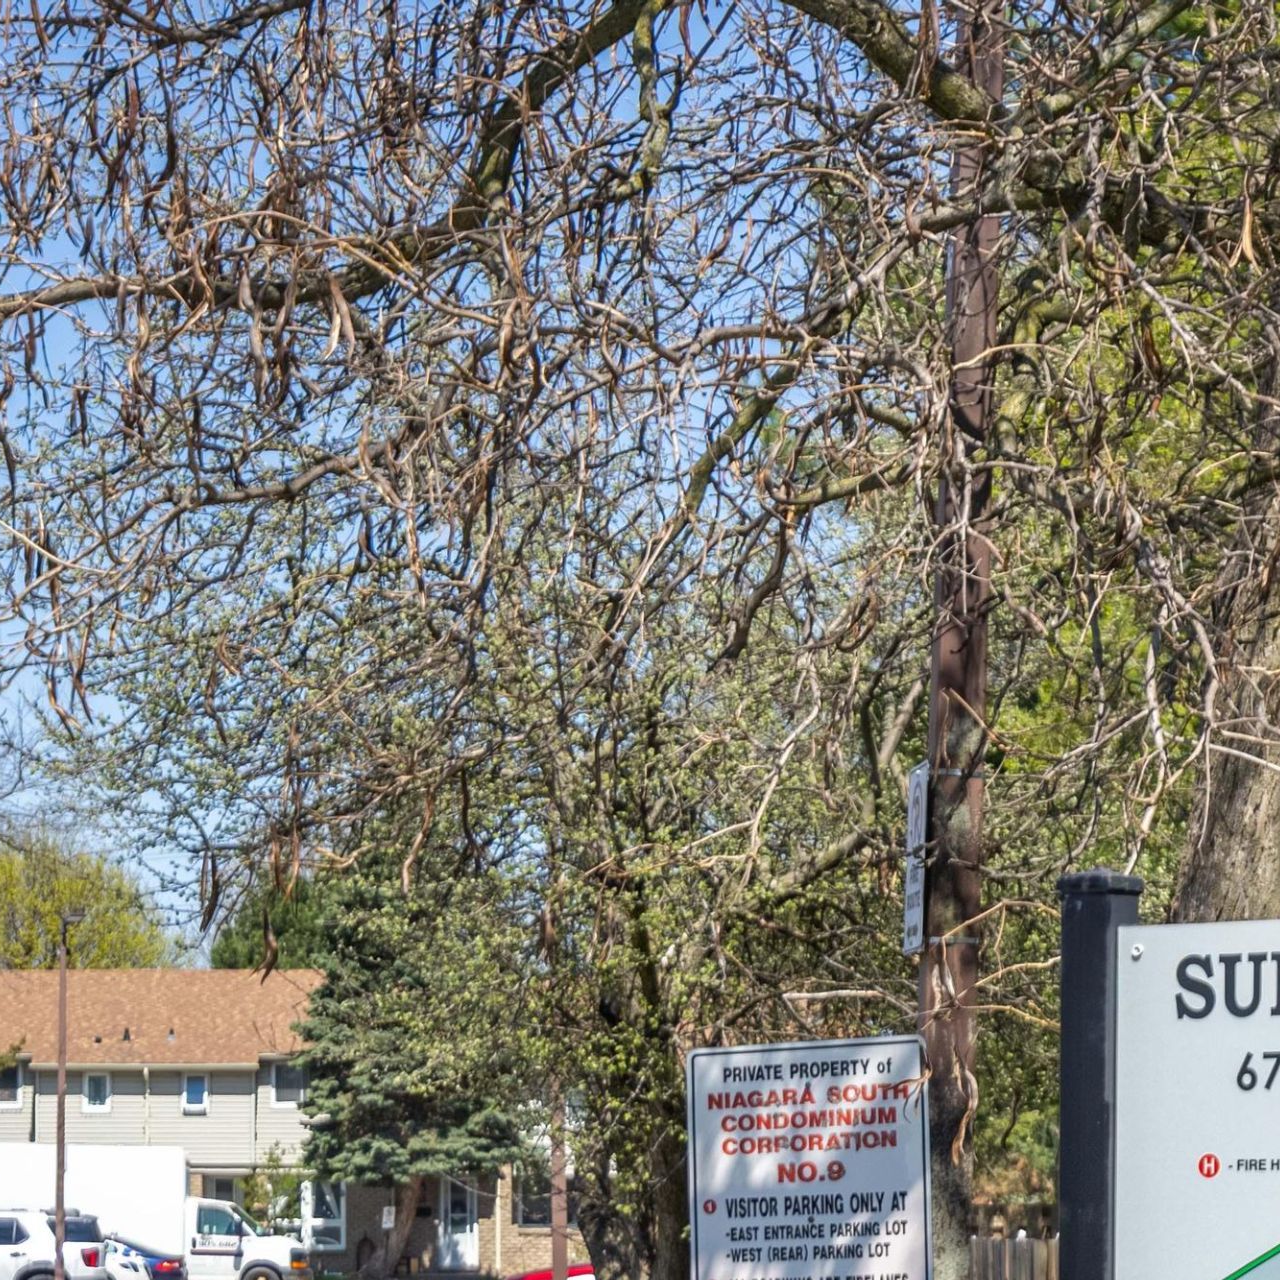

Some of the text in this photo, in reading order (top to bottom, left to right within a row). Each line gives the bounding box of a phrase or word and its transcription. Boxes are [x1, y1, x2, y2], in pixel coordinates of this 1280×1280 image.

[723, 1057, 892, 1083] PRIVATE PROPERTY of
[707, 1082, 910, 1111] NIAGARA SOUTH
[721, 1106, 897, 1133] CONDOMINIUM
[721, 1129, 897, 1156] CORPORATION
[777, 1160, 847, 1184] NO.9
[1203, 1157, 1215, 1175] H
[1236, 1158, 1267, 1171] FIRE
[707, 1191, 908, 1219] 1 VISITOR PARKING ONLY AT
[725, 1220, 908, 1242] -EAST ENTRANCE PARKING LOT
[726, 1242, 890, 1263] -WEST (REAR) PARKING LOT
